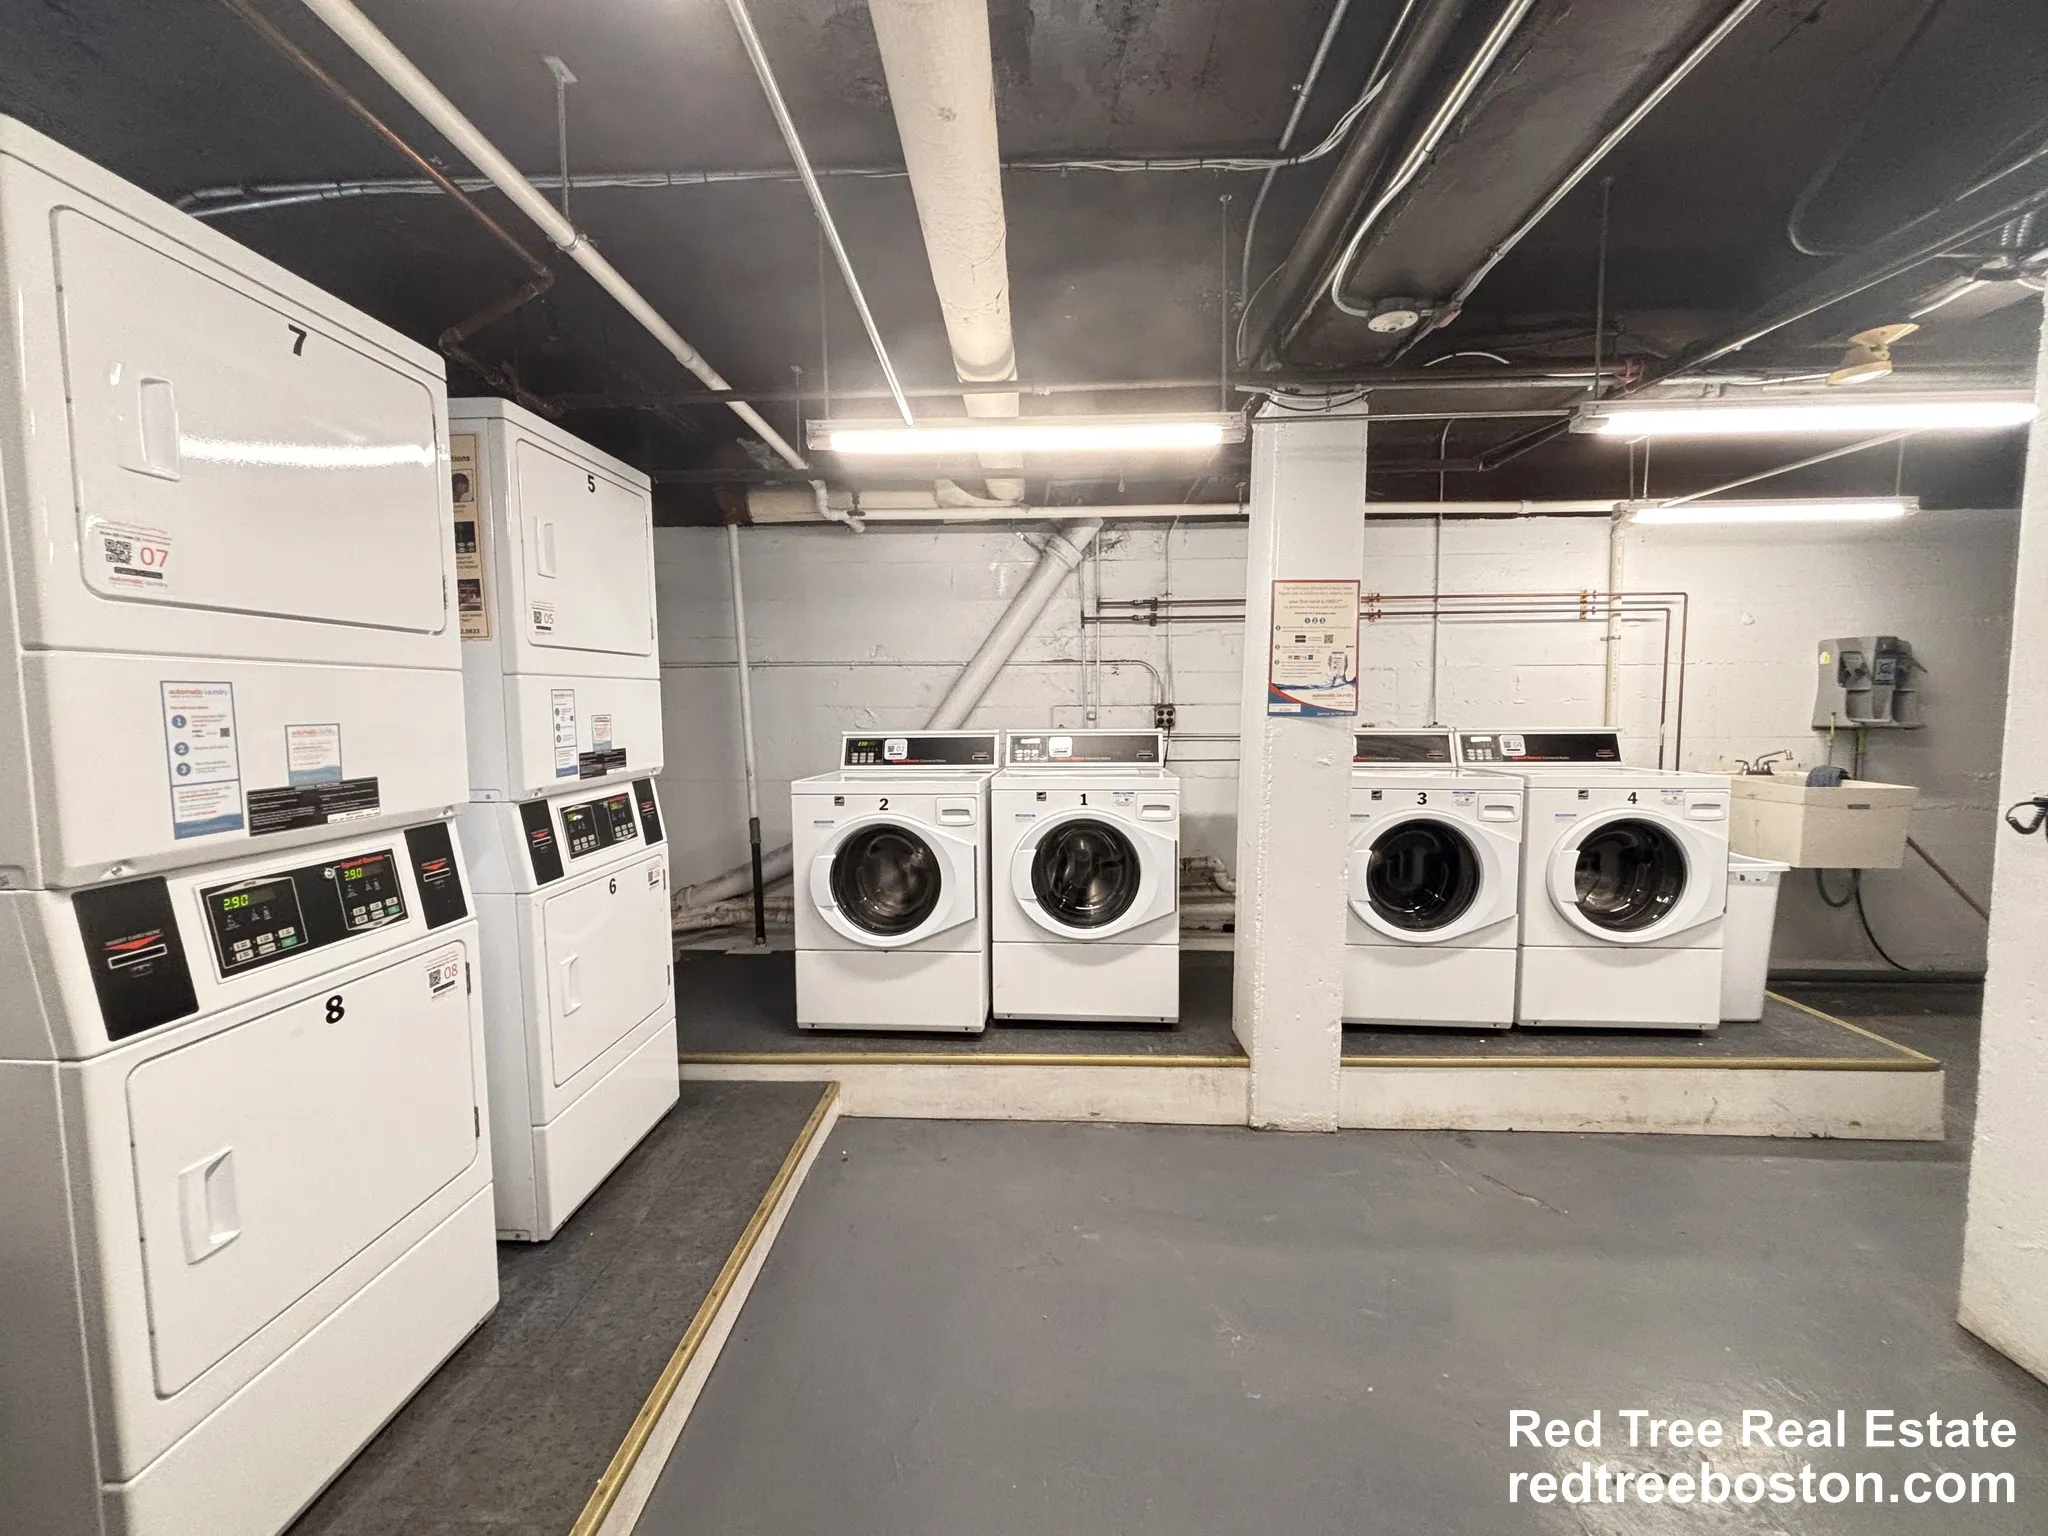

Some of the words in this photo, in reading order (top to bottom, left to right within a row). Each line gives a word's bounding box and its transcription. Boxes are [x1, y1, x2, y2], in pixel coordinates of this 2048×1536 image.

[288, 323, 307, 357] 7
[588, 474, 595, 493] 5
[140, 547, 168, 567] 07
[544, 613, 554, 624] 05
[879, 798, 889, 811] 2
[1080, 793, 1088, 805] 1
[1417, 792, 1427, 805] 3
[1627, 791, 1638, 805] 4
[609, 878, 617, 894] 6
[445, 963, 458, 979] 08
[326, 995, 345, 1024] 8
